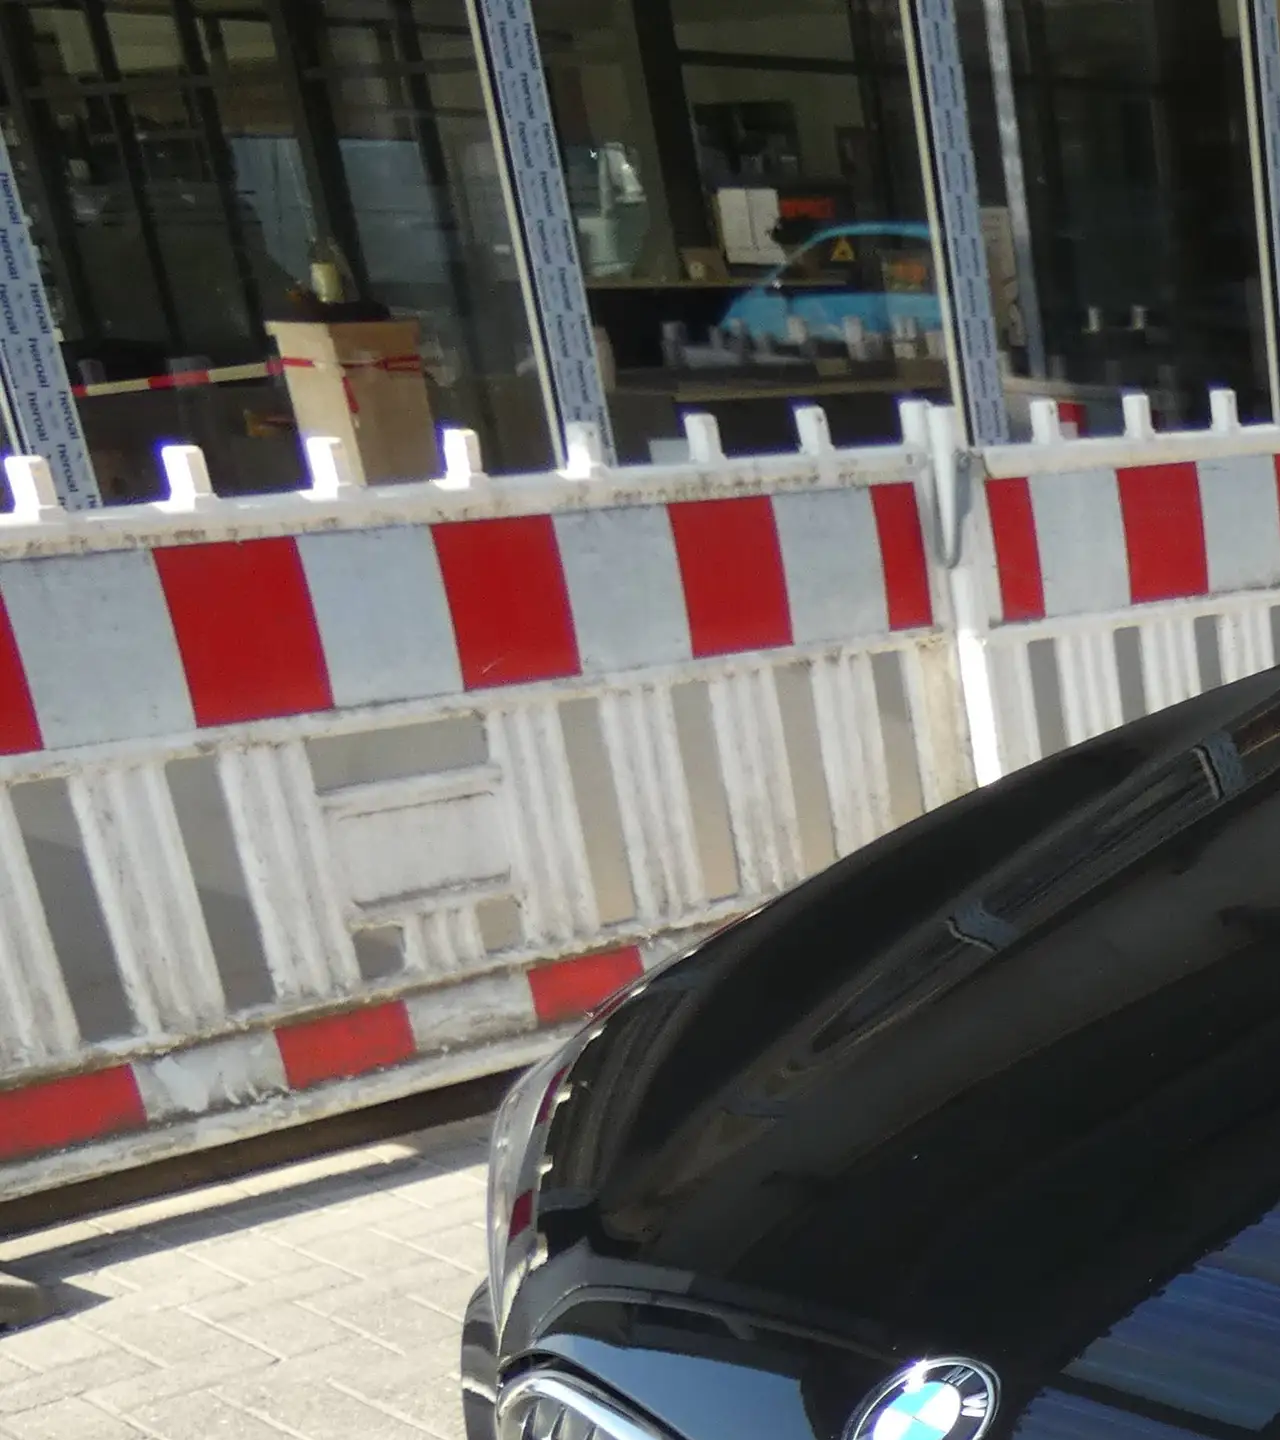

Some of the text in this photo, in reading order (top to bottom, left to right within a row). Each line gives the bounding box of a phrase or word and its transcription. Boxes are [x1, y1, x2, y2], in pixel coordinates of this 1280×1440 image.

[29, 283, 50, 335] heroal
[28, 337, 50, 388] heroal
[27, 392, 49, 442] heroal
[58, 391, 80, 440] heroal
[56, 444, 79, 493] heroal
